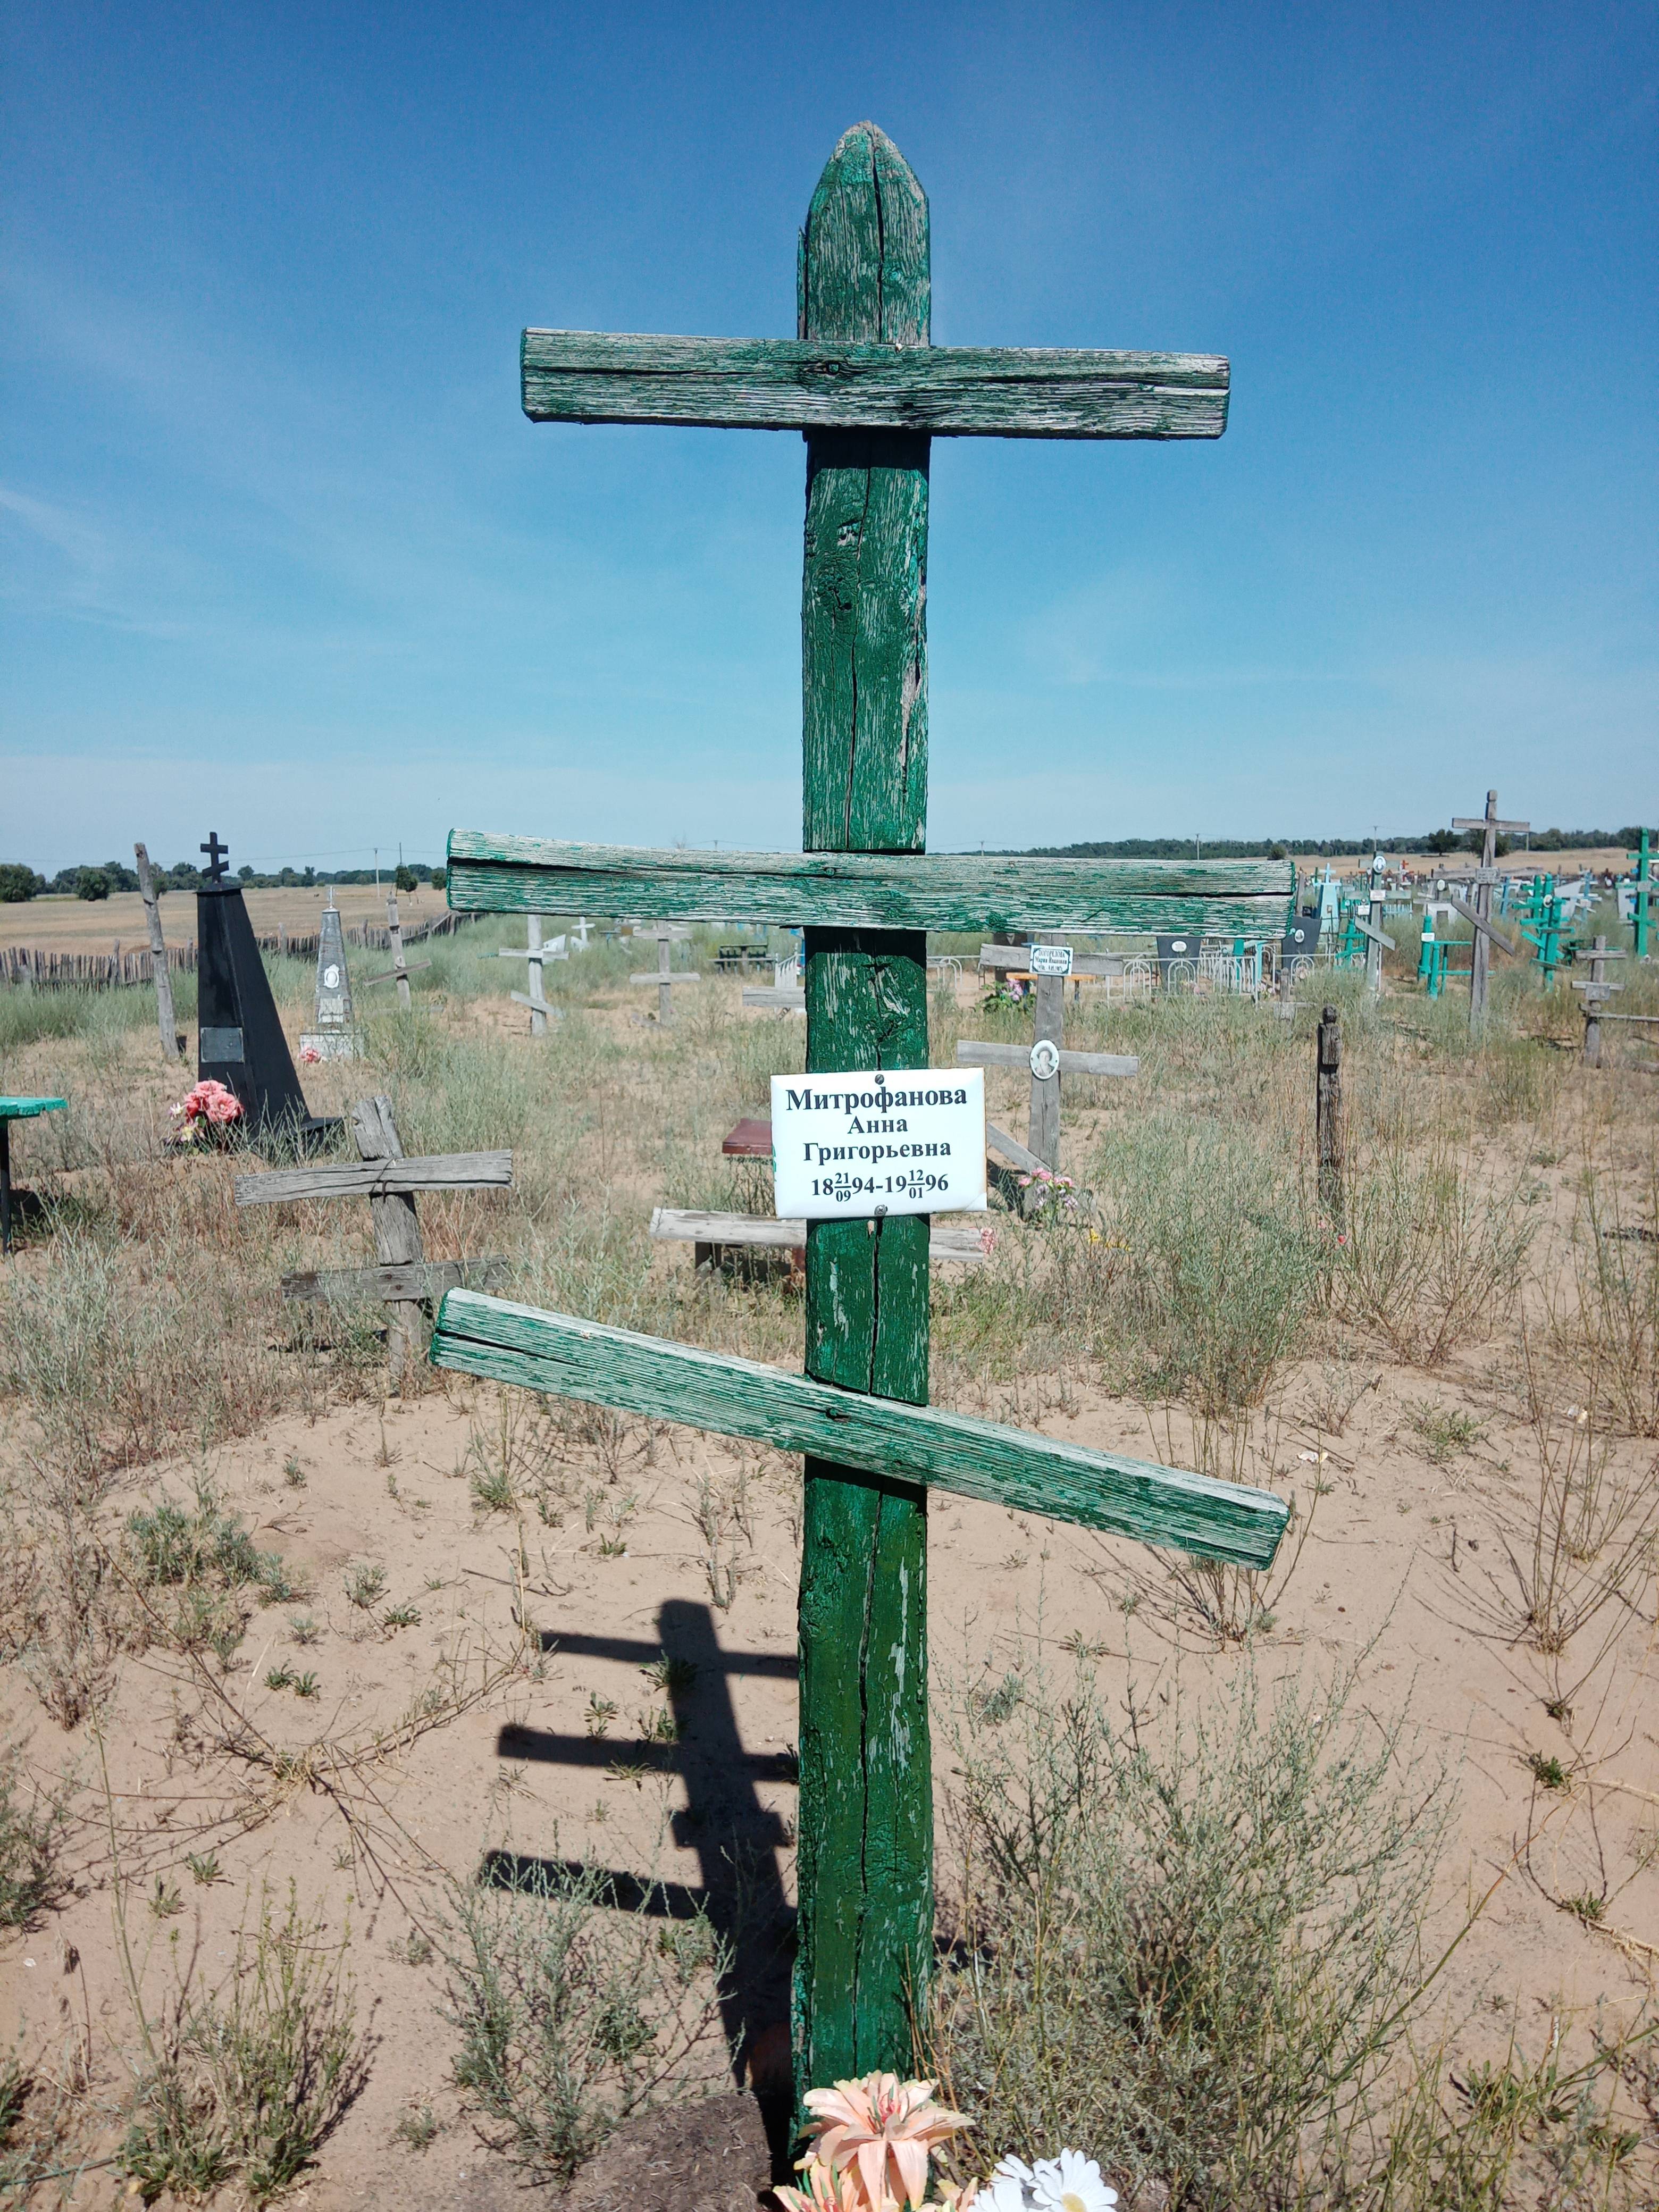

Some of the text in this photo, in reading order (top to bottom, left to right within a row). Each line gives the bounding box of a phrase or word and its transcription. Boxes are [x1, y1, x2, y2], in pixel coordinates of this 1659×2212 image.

[785, 1086, 967, 1115] Митрофанова
[847, 1116, 908, 1134] Анна
[803, 1143, 951, 1166] Григорьевна
